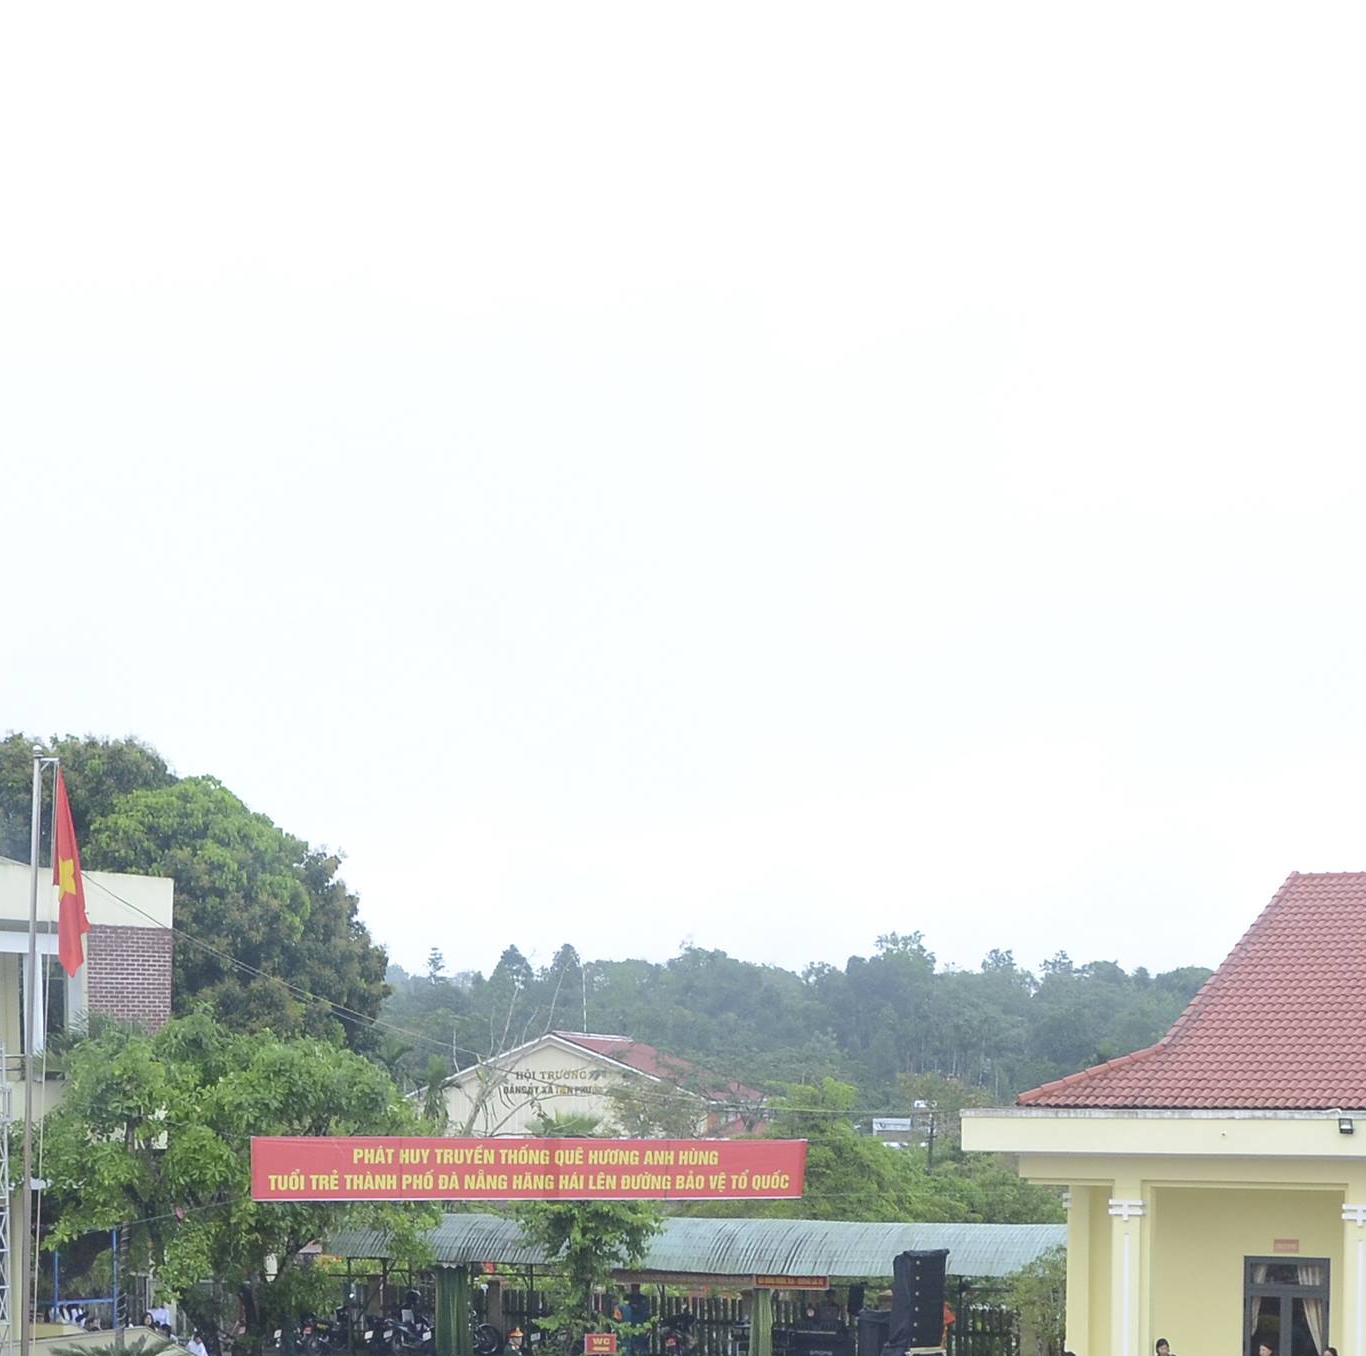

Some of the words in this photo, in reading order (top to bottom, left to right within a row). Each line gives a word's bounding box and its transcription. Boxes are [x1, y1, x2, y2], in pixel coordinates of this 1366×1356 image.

[516, 1068, 535, 1081] HỘI
[353, 1146, 394, 1164] PHÁT
[399, 1149, 429, 1164] HUY
[435, 1146, 494, 1164] TRUYỀN
[500, 1144, 549, 1164] THỐNG
[554, 1147, 584, 1165] QUÊ
[589, 1149, 639, 1165] HƯƠNG
[644, 1150, 674, 1165] ANH
[679, 1147, 718, 1165] HÙNG
[269, 1169, 305, 1190] TUỔI
[310, 1169, 339, 1190] TRẺ
[344, 1172, 397, 1190] THÀNH
[402, 1170, 433, 1190] PHỐ
[439, 1172, 459, 1190] ĐÀ
[464, 1170, 507, 1190] NẴNG
[513, 1172, 554, 1190] HĂNG
[559, 1171, 584, 1190] HÁI
[589, 1171, 617, 1190] LÊN
[621, 1172, 671, 1190] ĐƯỜNG
[676, 1170, 704, 1190] BẢO
[709, 1171, 726, 1193] VỆ
[731, 1169, 748, 1190] TỔ
[752, 1170, 790, 1190] QUỐC
[592, 1337, 611, 1346] WC
